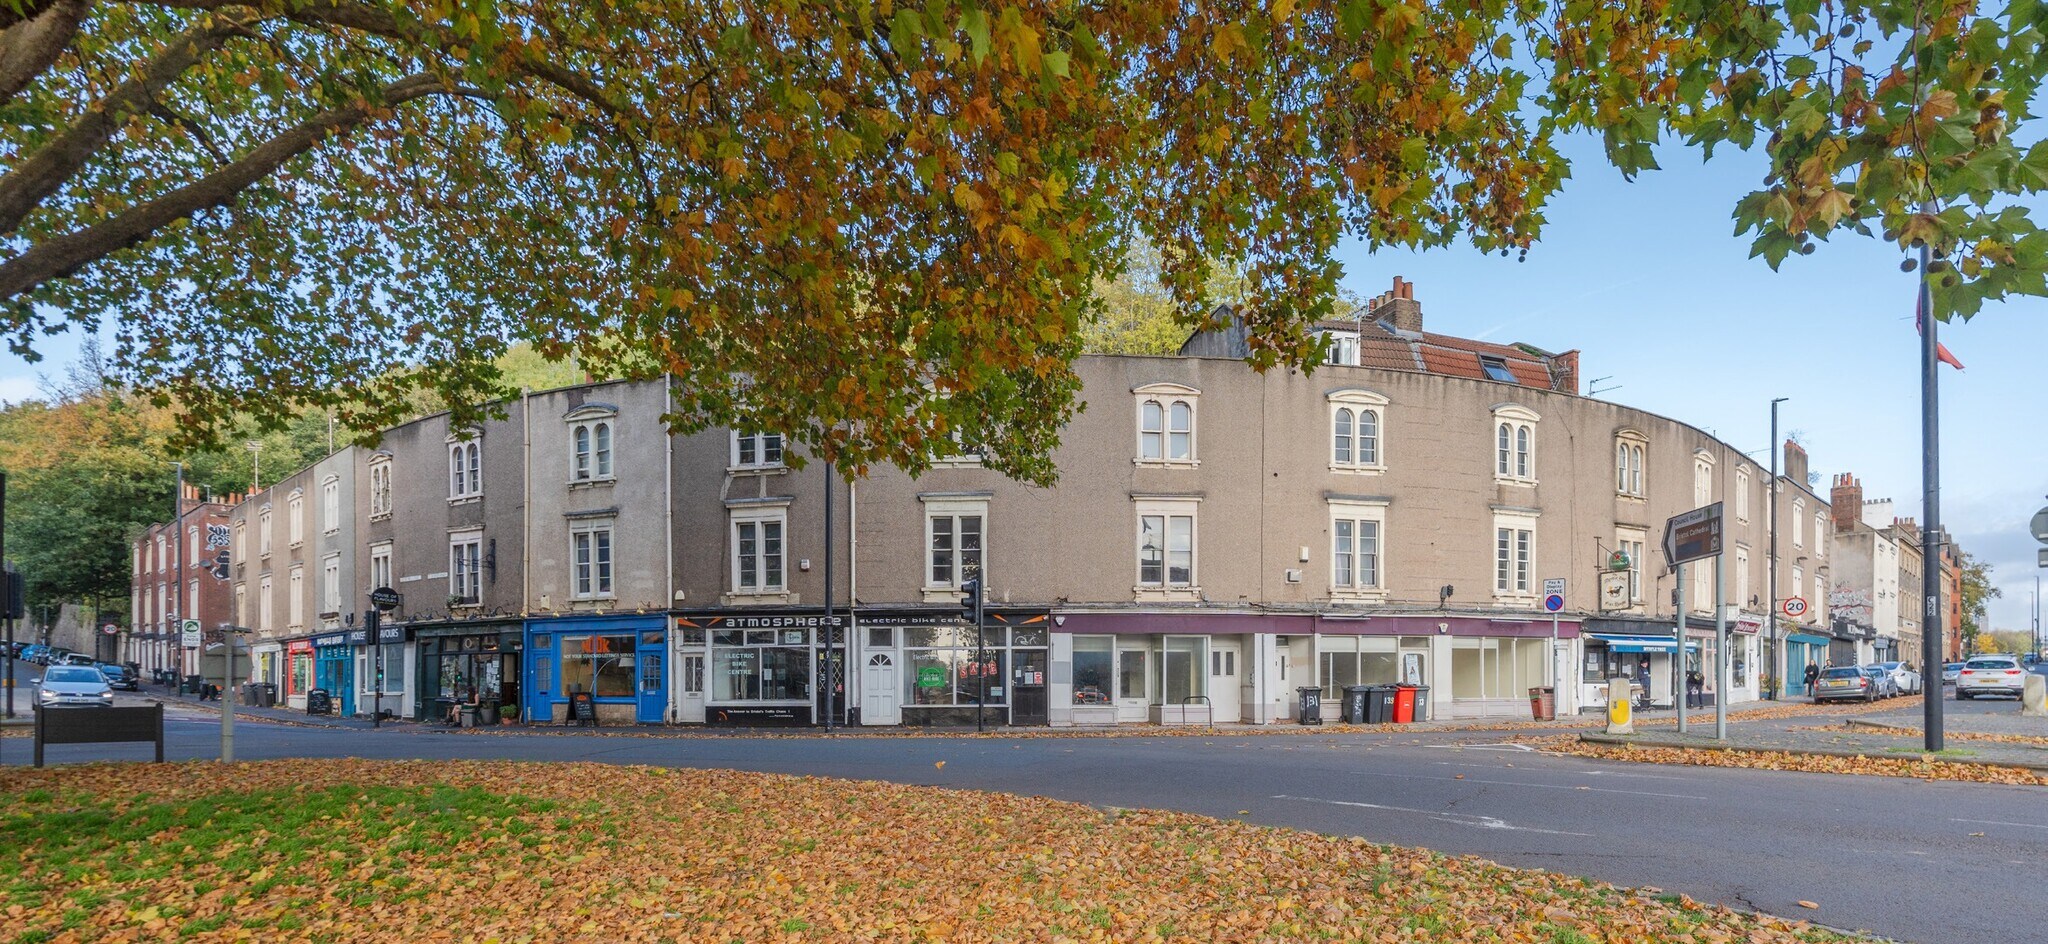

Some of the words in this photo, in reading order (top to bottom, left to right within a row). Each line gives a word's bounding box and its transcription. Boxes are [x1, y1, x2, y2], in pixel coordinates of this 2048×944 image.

[1690, 512, 1702, 520] House
[1787, 602, 1804, 611] 20
[581, 635, 610, 654] NOOK
